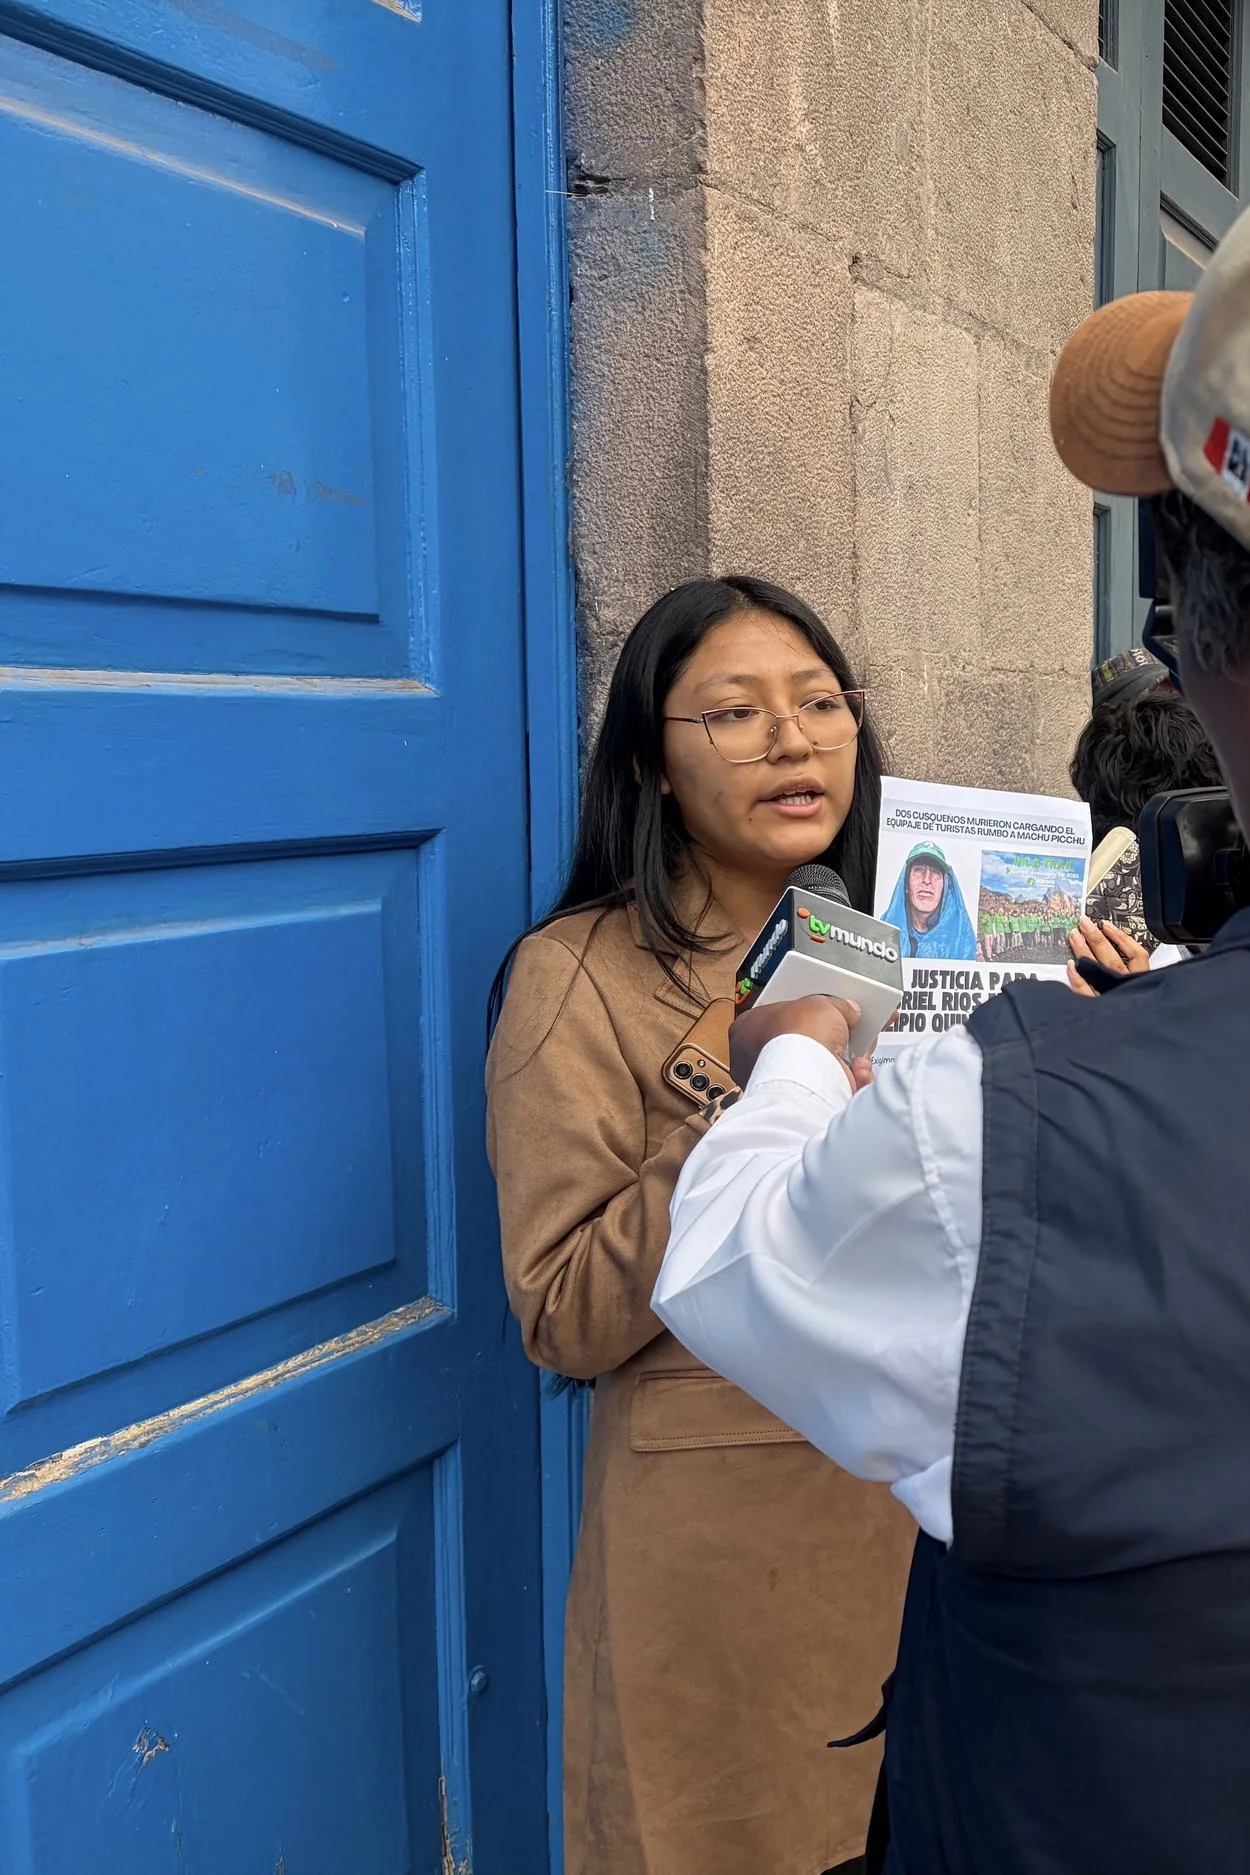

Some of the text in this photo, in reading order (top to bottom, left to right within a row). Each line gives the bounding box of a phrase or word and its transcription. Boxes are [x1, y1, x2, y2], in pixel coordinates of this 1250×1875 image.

[886, 817, 1085, 846] EQUIPAJE DE TURISTAS RUMBO A MACHU PICCHU
[895, 809, 911, 819] DOS
[967, 817, 1012, 829] MURIERON
[1012, 821, 1064, 834] CARGANDO
[1065, 827, 1075, 835] EL
[911, 969, 985, 990] JUSTICIA
